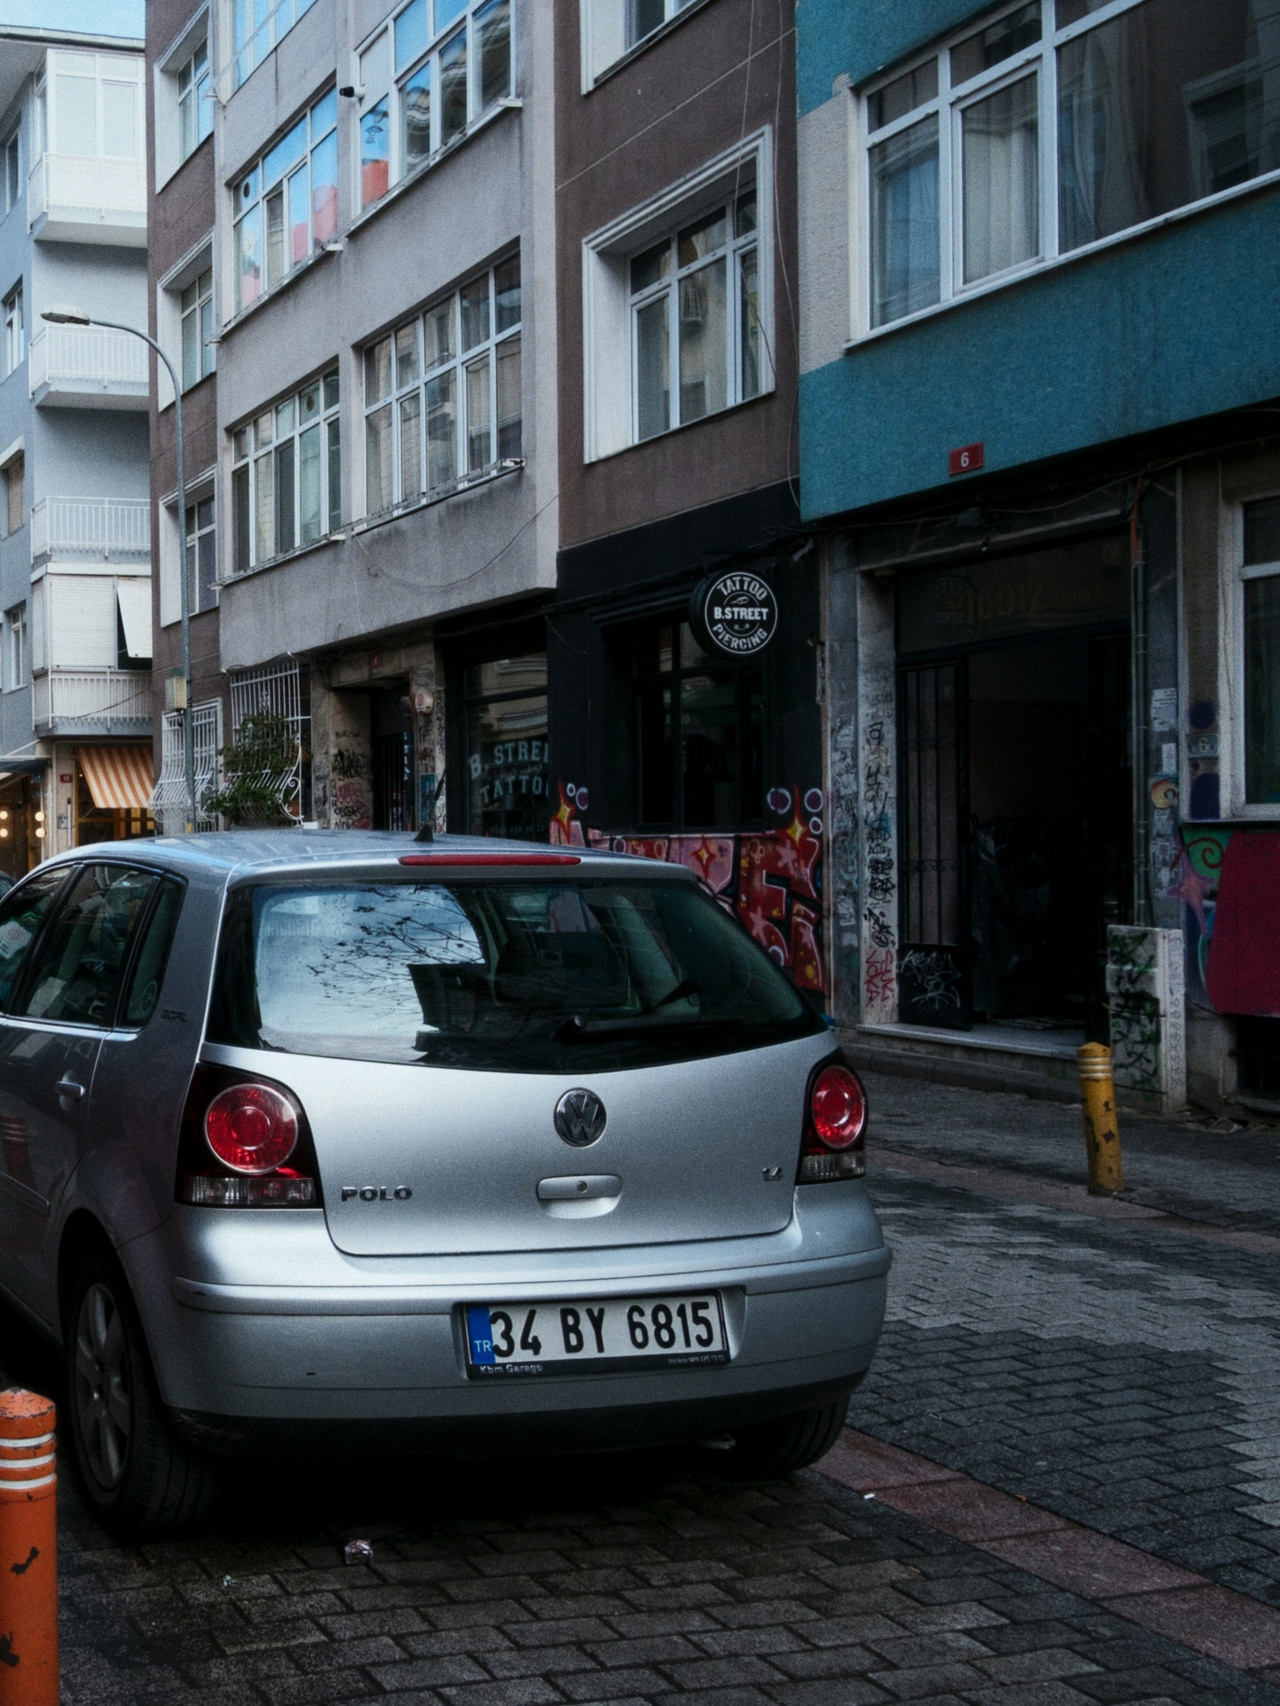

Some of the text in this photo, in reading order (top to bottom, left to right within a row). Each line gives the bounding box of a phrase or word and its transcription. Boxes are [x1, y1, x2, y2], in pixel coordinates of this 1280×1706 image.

[960, 451, 970, 468] 6
[716, 576, 768, 601] TATTOO
[713, 606, 769, 620] B.STREET
[712, 622, 768, 650] PIERCING
[341, 1185, 413, 1202] POLO
[489, 1301, 714, 1358] 34 BY 6815
[474, 1339, 493, 1352] TR
[479, 1363, 543, 1375] Kbm Garage
